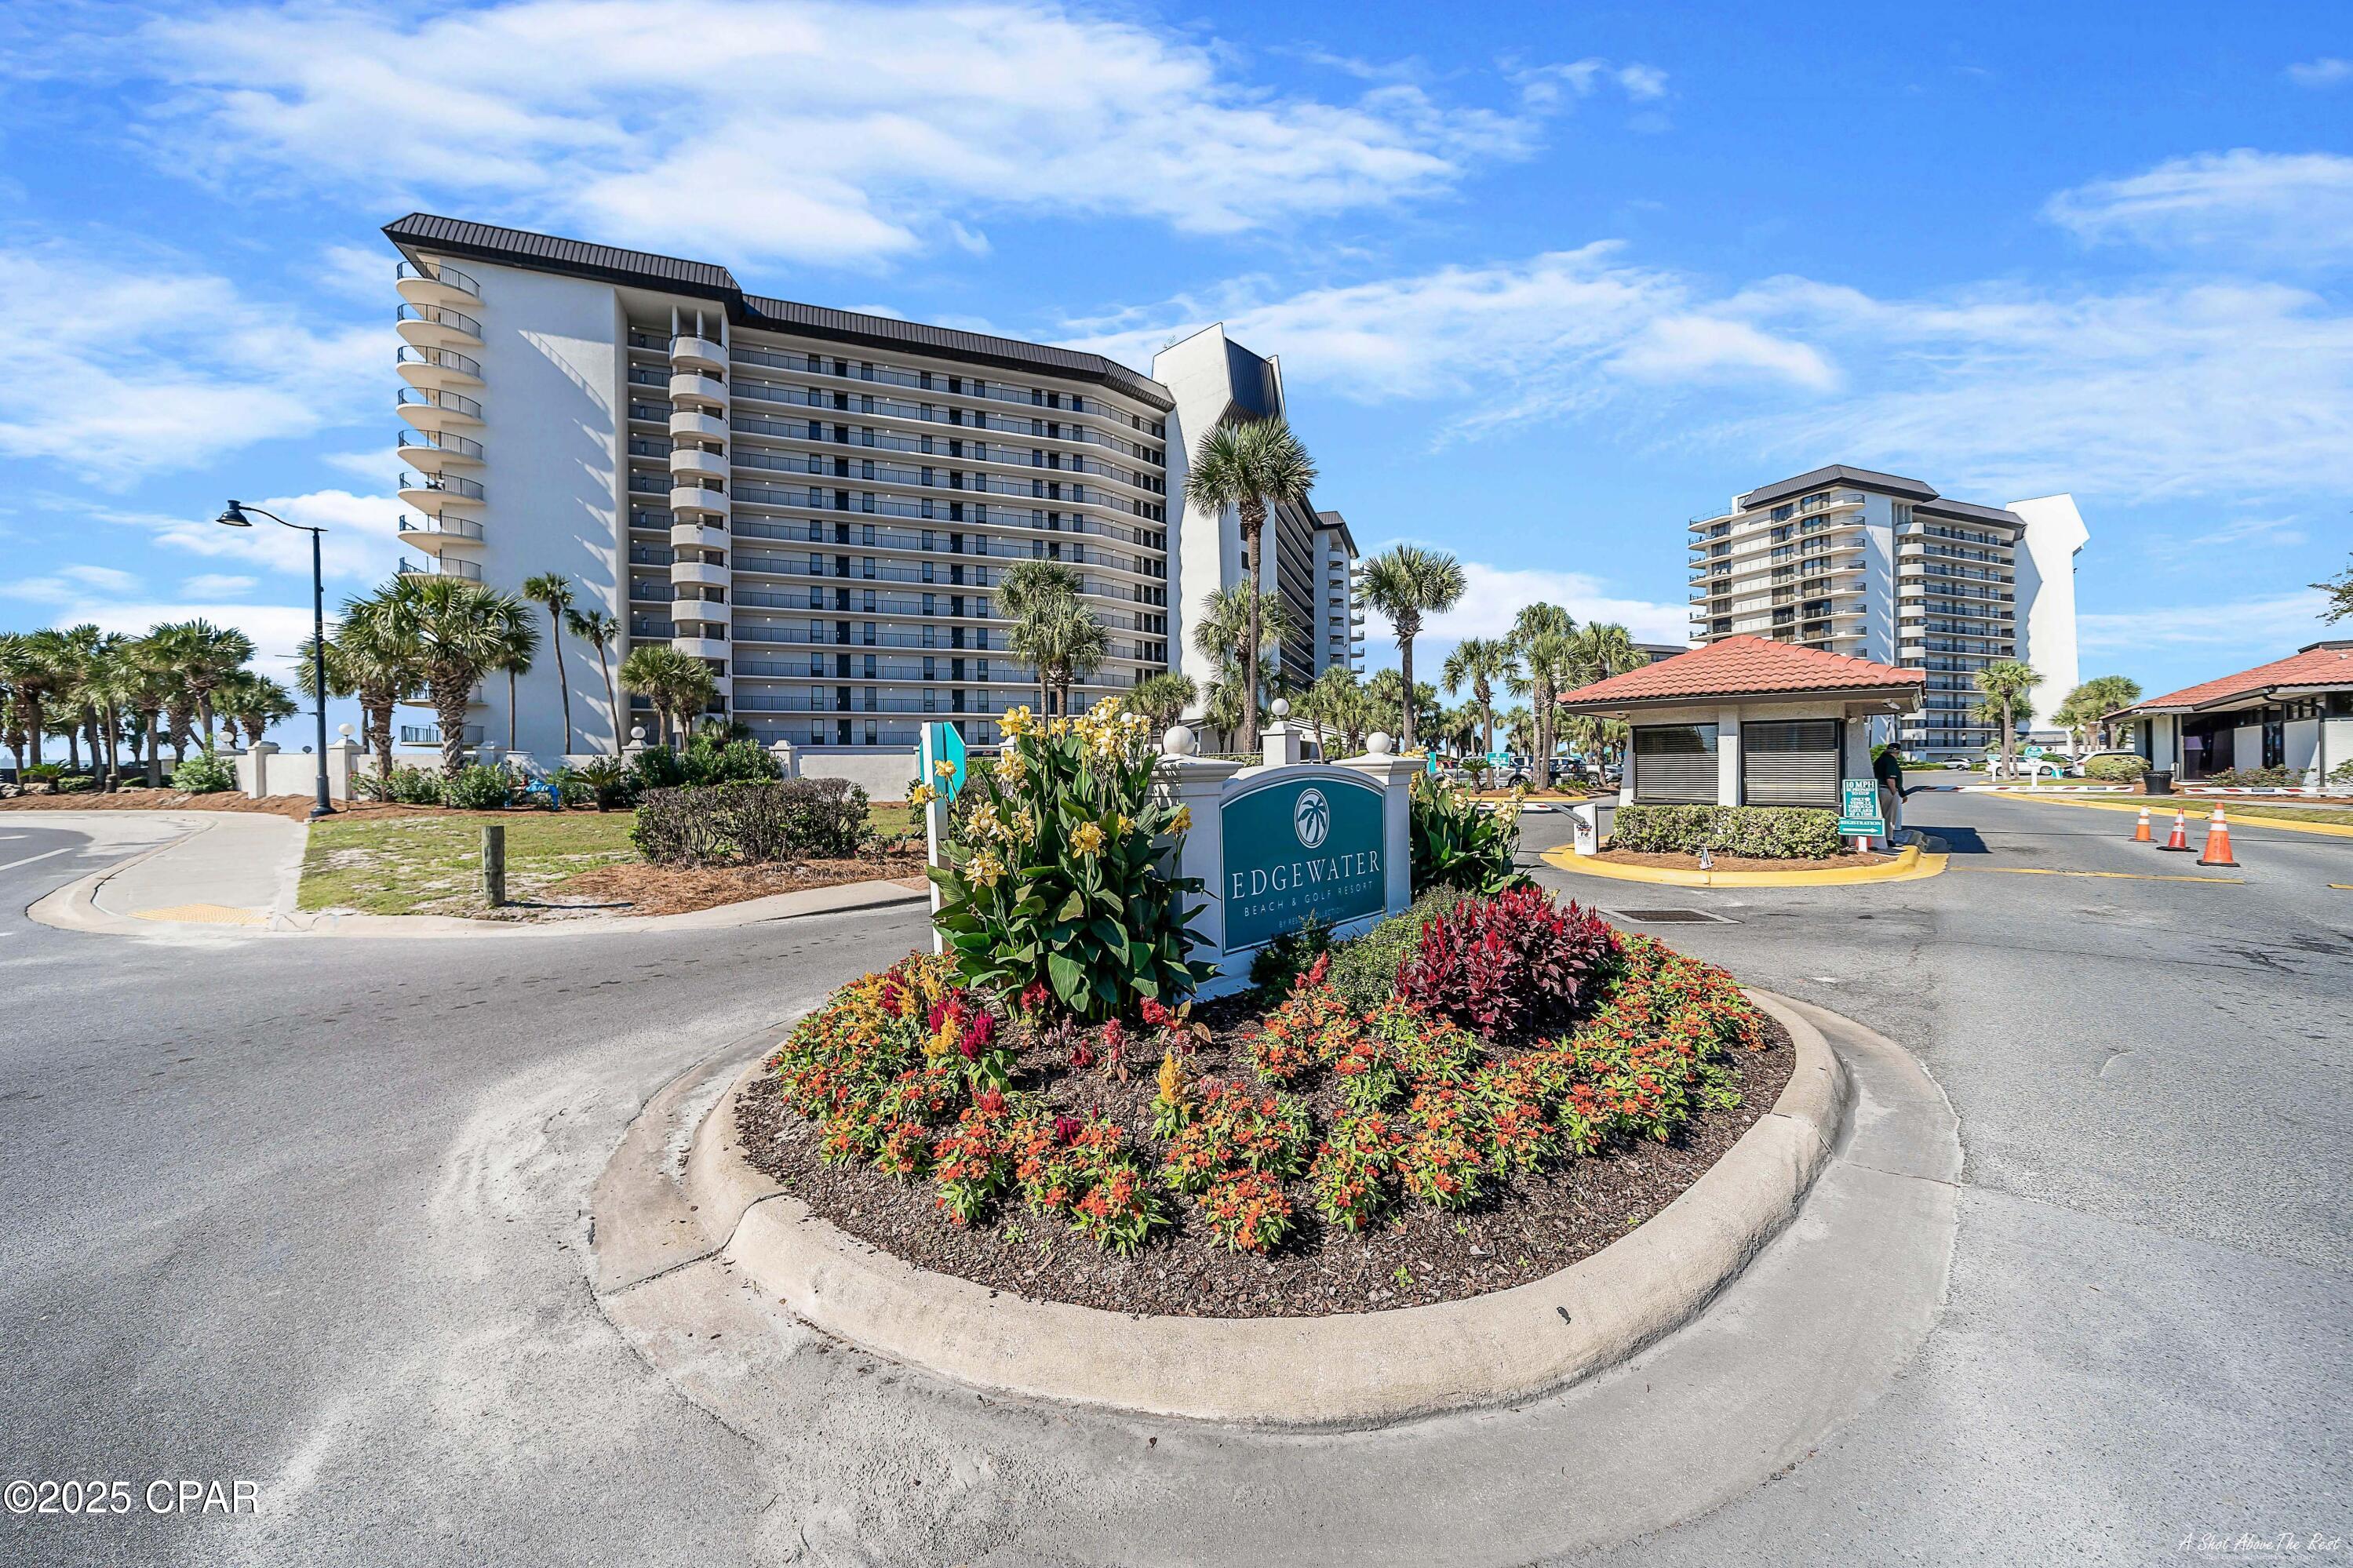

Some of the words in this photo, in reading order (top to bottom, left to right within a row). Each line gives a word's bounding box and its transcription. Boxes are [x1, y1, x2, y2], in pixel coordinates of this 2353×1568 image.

[1232, 850, 1379, 900] EDGEWATER
[1244, 899, 1284, 917] BEACH
[1291, 897, 1297, 907] &
[1304, 889, 1331, 904] GOLF
[1338, 880, 1372, 897] RESORT
